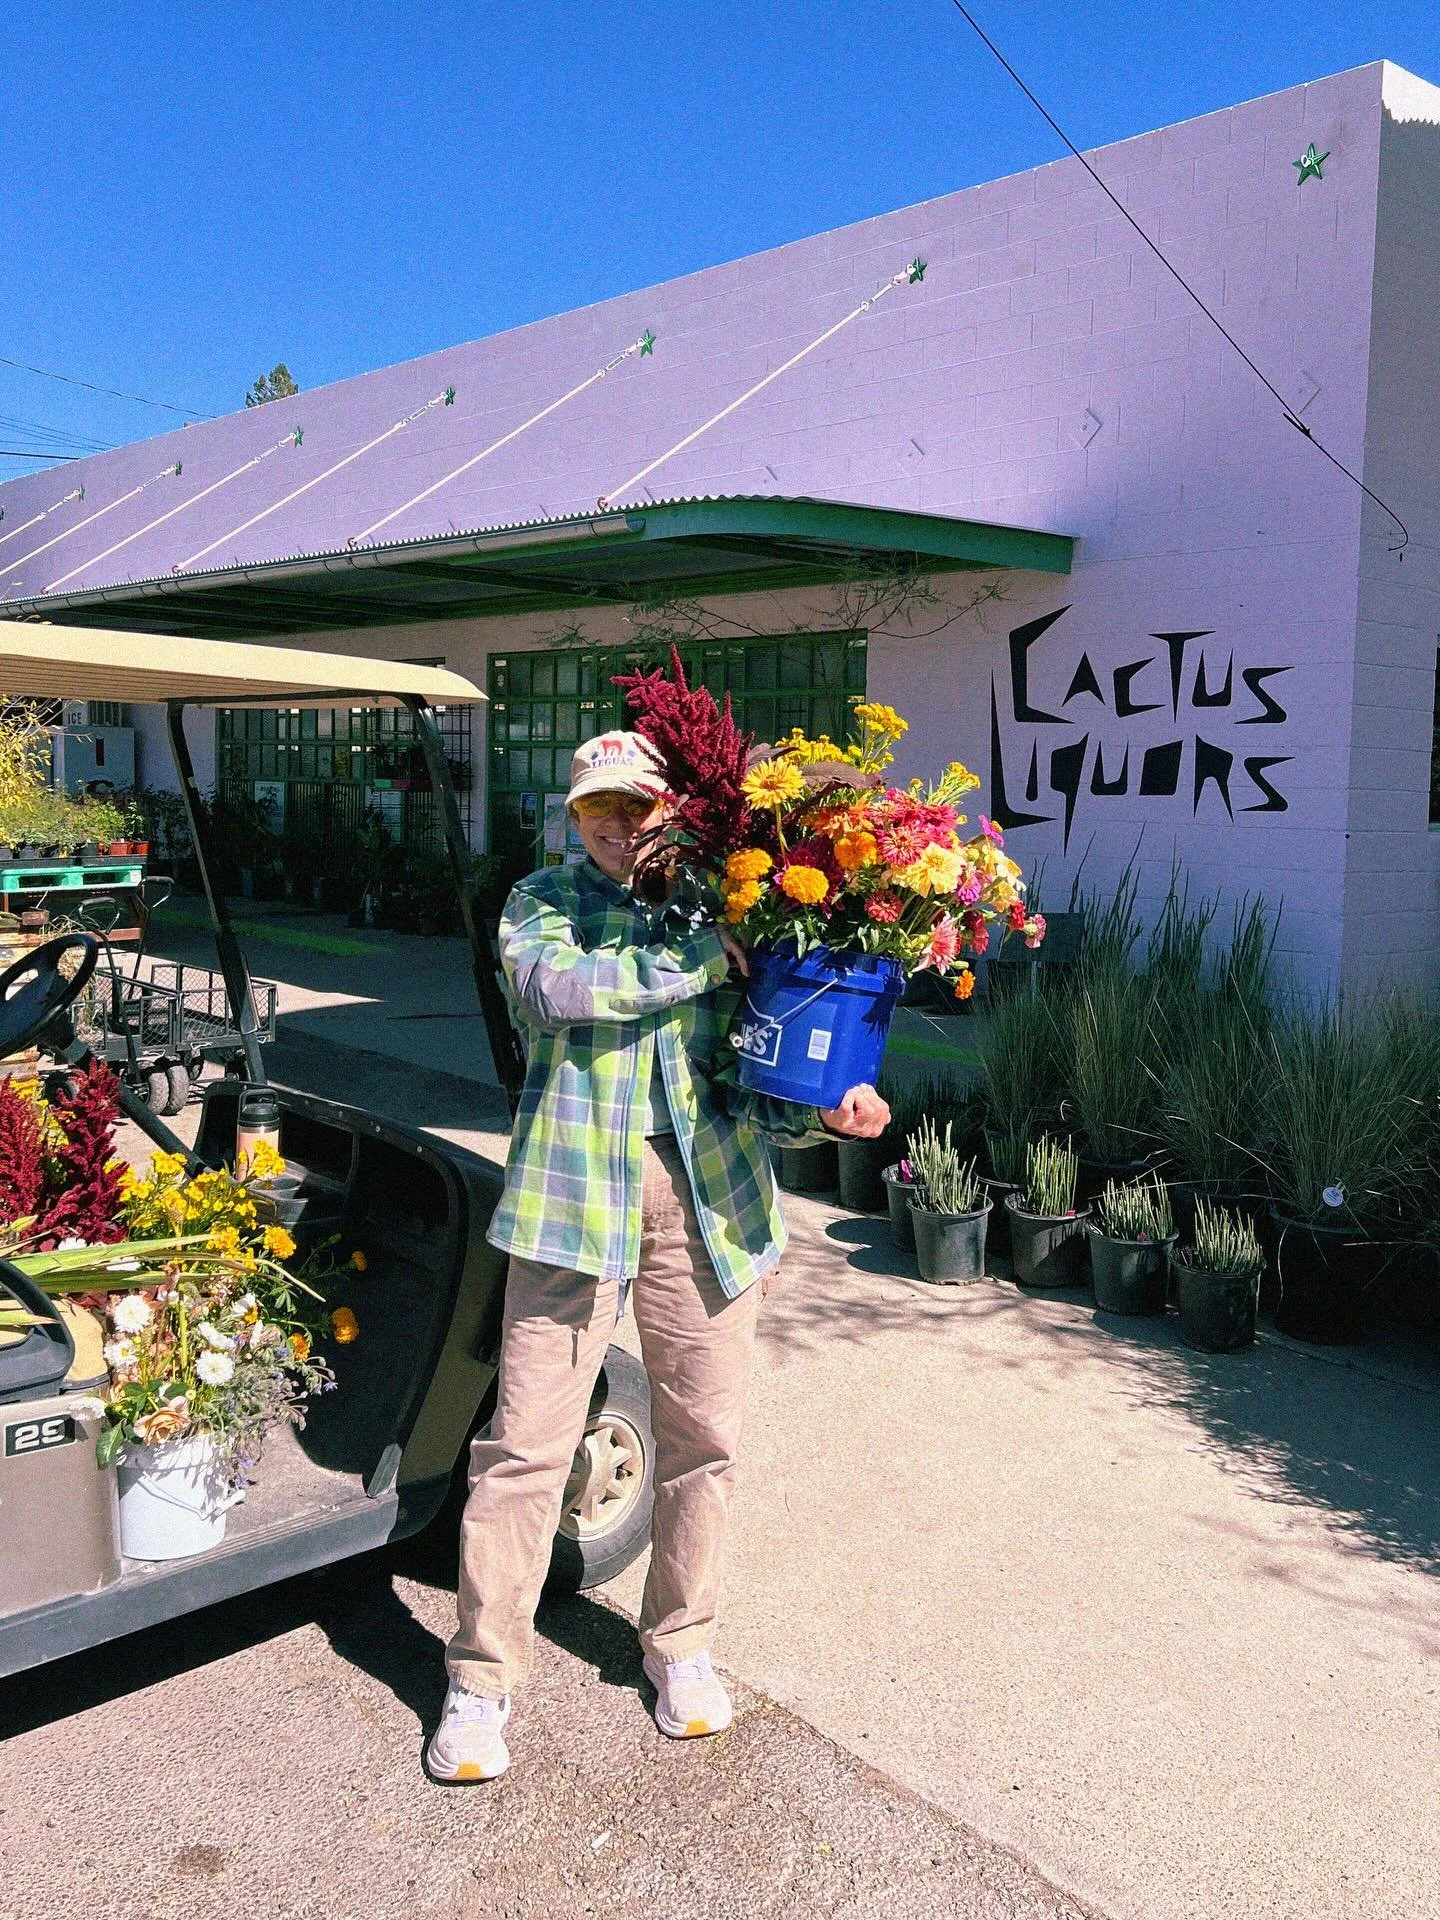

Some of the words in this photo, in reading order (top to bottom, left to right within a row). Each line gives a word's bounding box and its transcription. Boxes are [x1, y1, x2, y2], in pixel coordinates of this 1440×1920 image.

[1009, 604, 1295, 724] CACTUS
[67, 712, 82, 725] ICE
[592, 757, 634, 769] LEGUAS
[991, 669, 1295, 858] LIQUORS
[15, 1420, 65, 1450] 29
